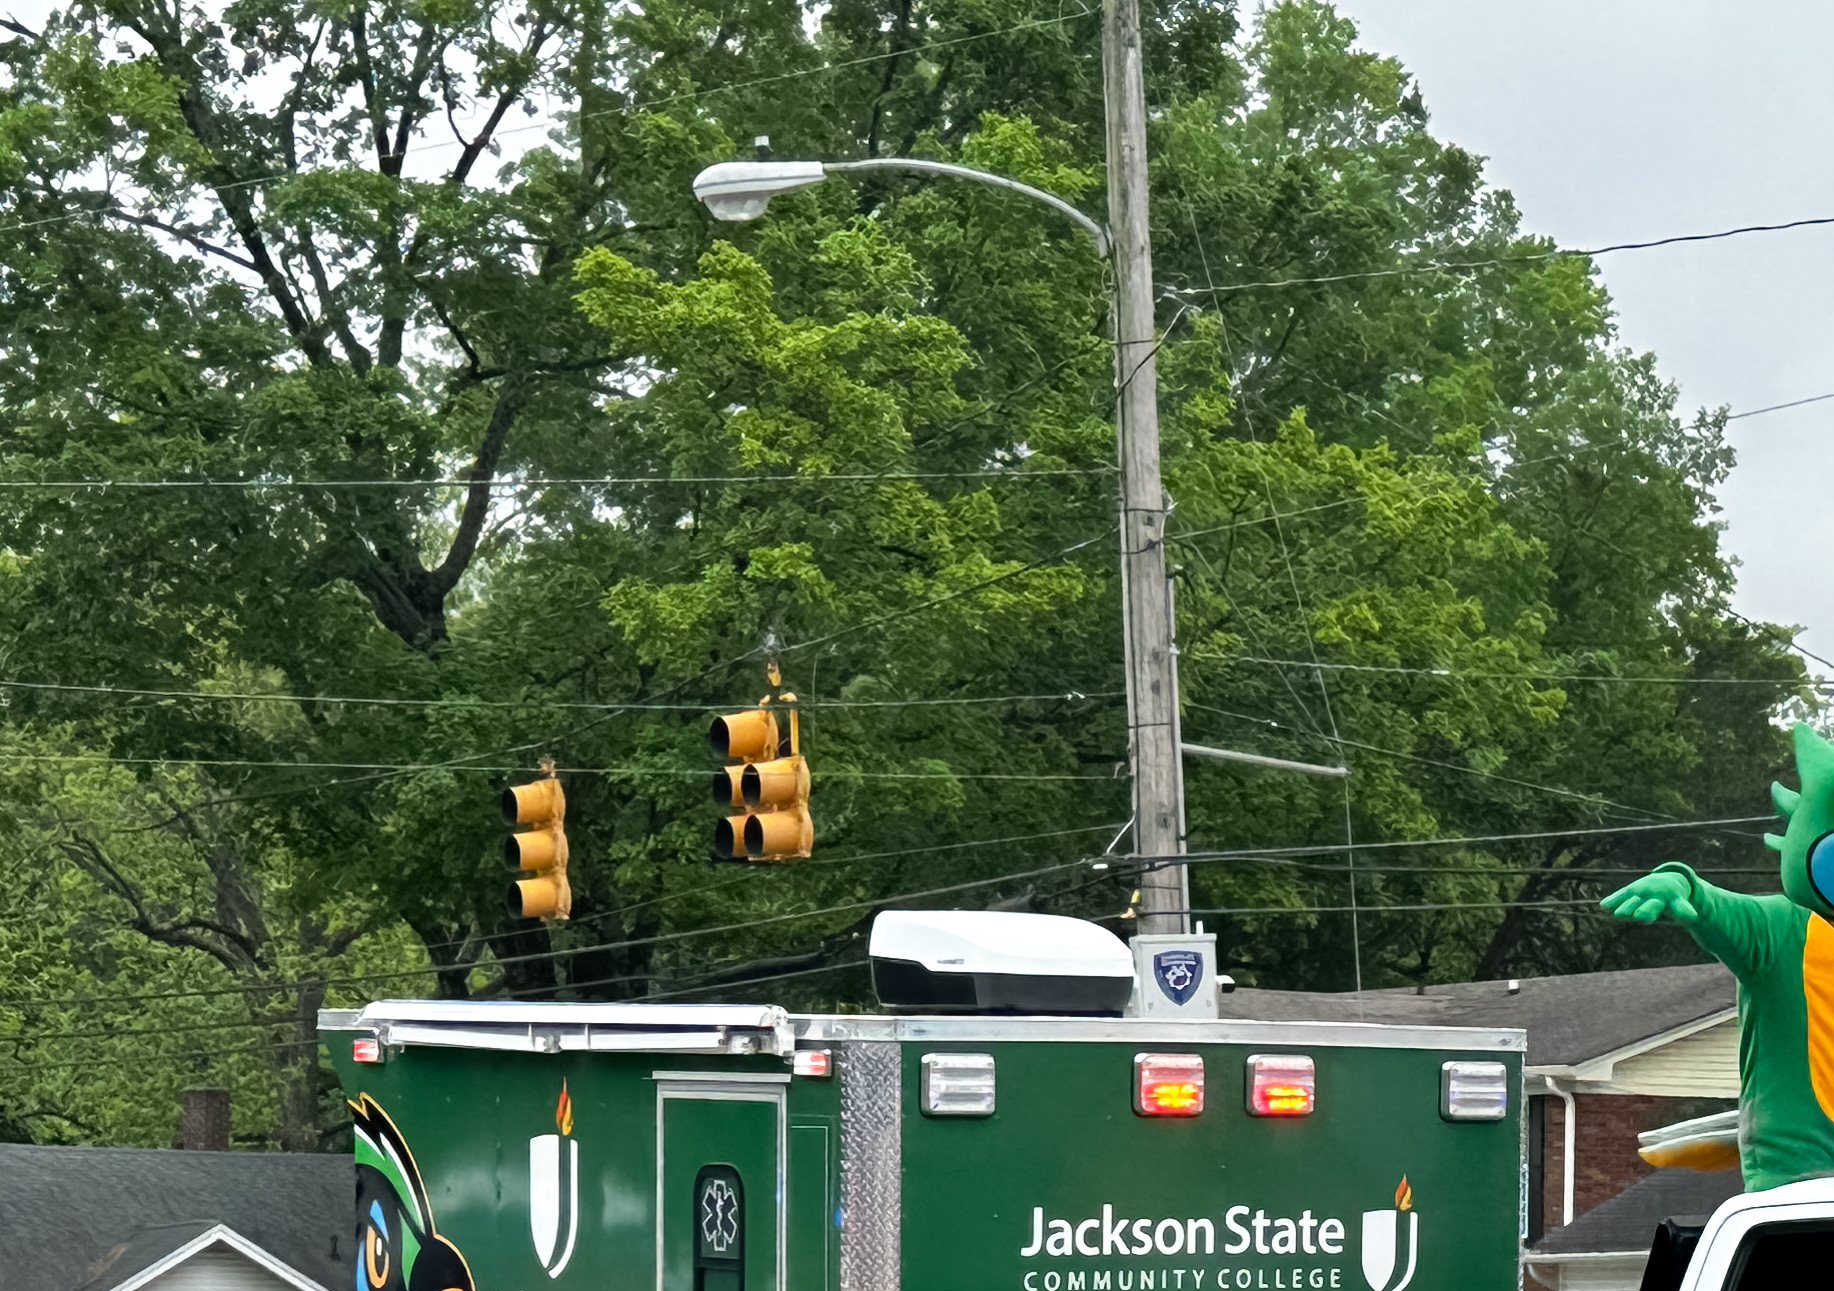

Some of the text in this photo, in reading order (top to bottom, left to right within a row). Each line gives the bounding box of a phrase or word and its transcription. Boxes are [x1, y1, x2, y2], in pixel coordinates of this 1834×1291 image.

[1020, 1203, 1346, 1257] Jackson State
[1023, 1267, 1342, 1291] COMMUNITY COLLEGE
